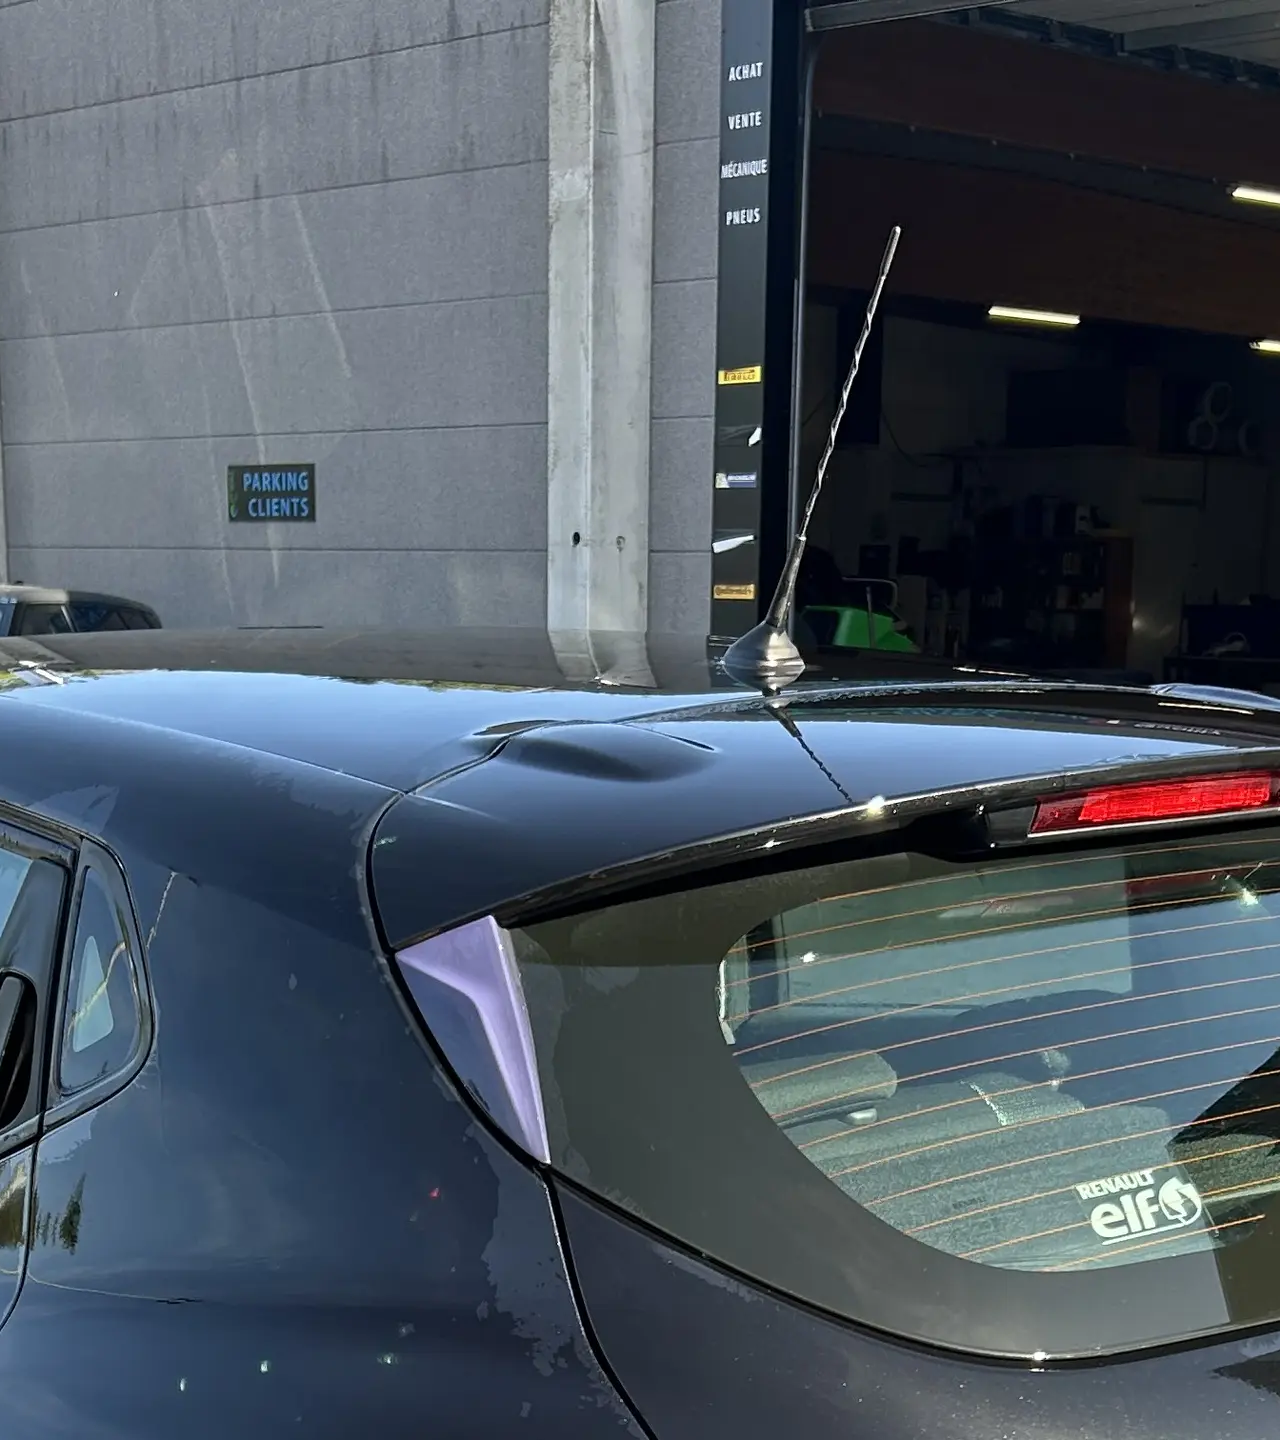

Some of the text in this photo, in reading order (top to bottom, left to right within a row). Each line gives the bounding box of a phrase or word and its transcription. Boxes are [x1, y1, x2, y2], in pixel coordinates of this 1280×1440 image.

[728, 62, 764, 82] ACHAT
[727, 111, 763, 131] VENTE
[720, 159, 768, 179] MÉCANIQUE
[725, 208, 761, 226] PNEUS
[243, 472, 309, 491] PARKING
[248, 498, 309, 517] CLIENTS
[1075, 1169, 1155, 1200] RENAULT
[1091, 1189, 1160, 1238] elf
